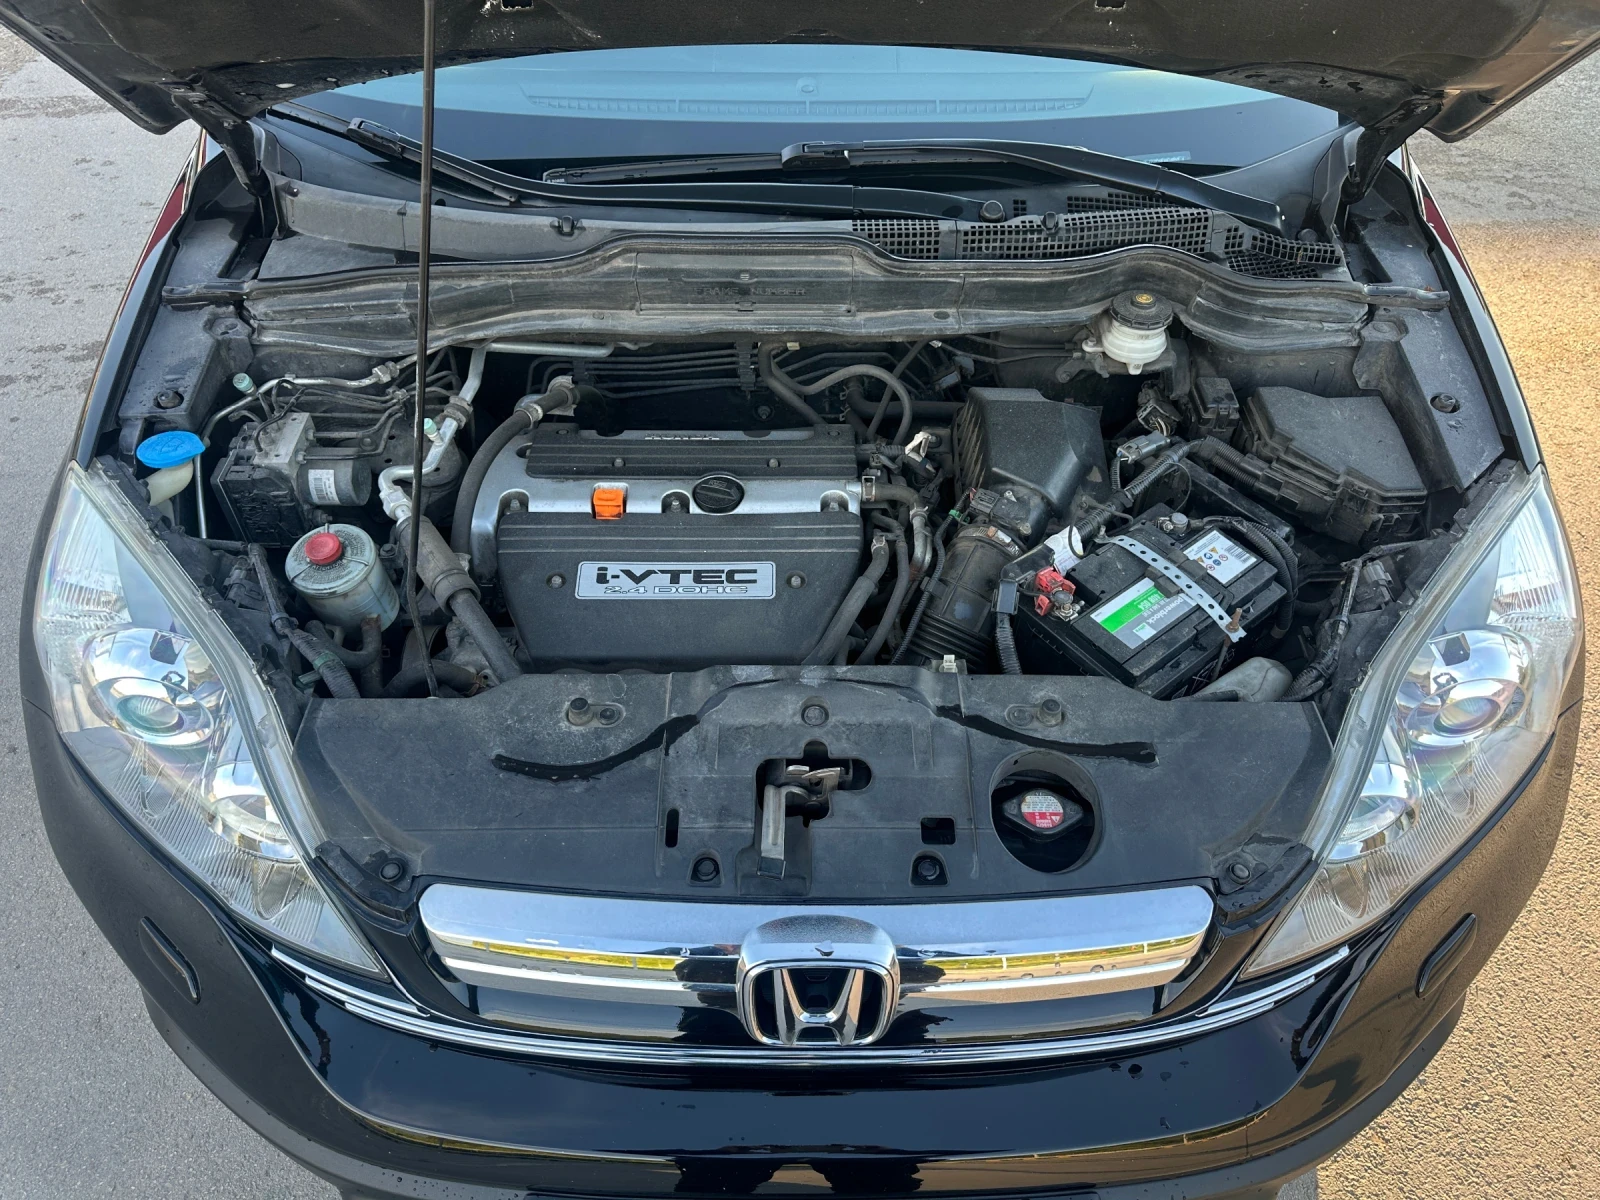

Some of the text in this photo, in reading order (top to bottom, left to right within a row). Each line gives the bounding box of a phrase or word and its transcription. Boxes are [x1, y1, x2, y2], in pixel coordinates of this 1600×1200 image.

[596, 566, 757, 585] i-VTEC
[603, 585, 748, 594] 2.4 DOHC
[1147, 597, 1184, 624] powerblock
